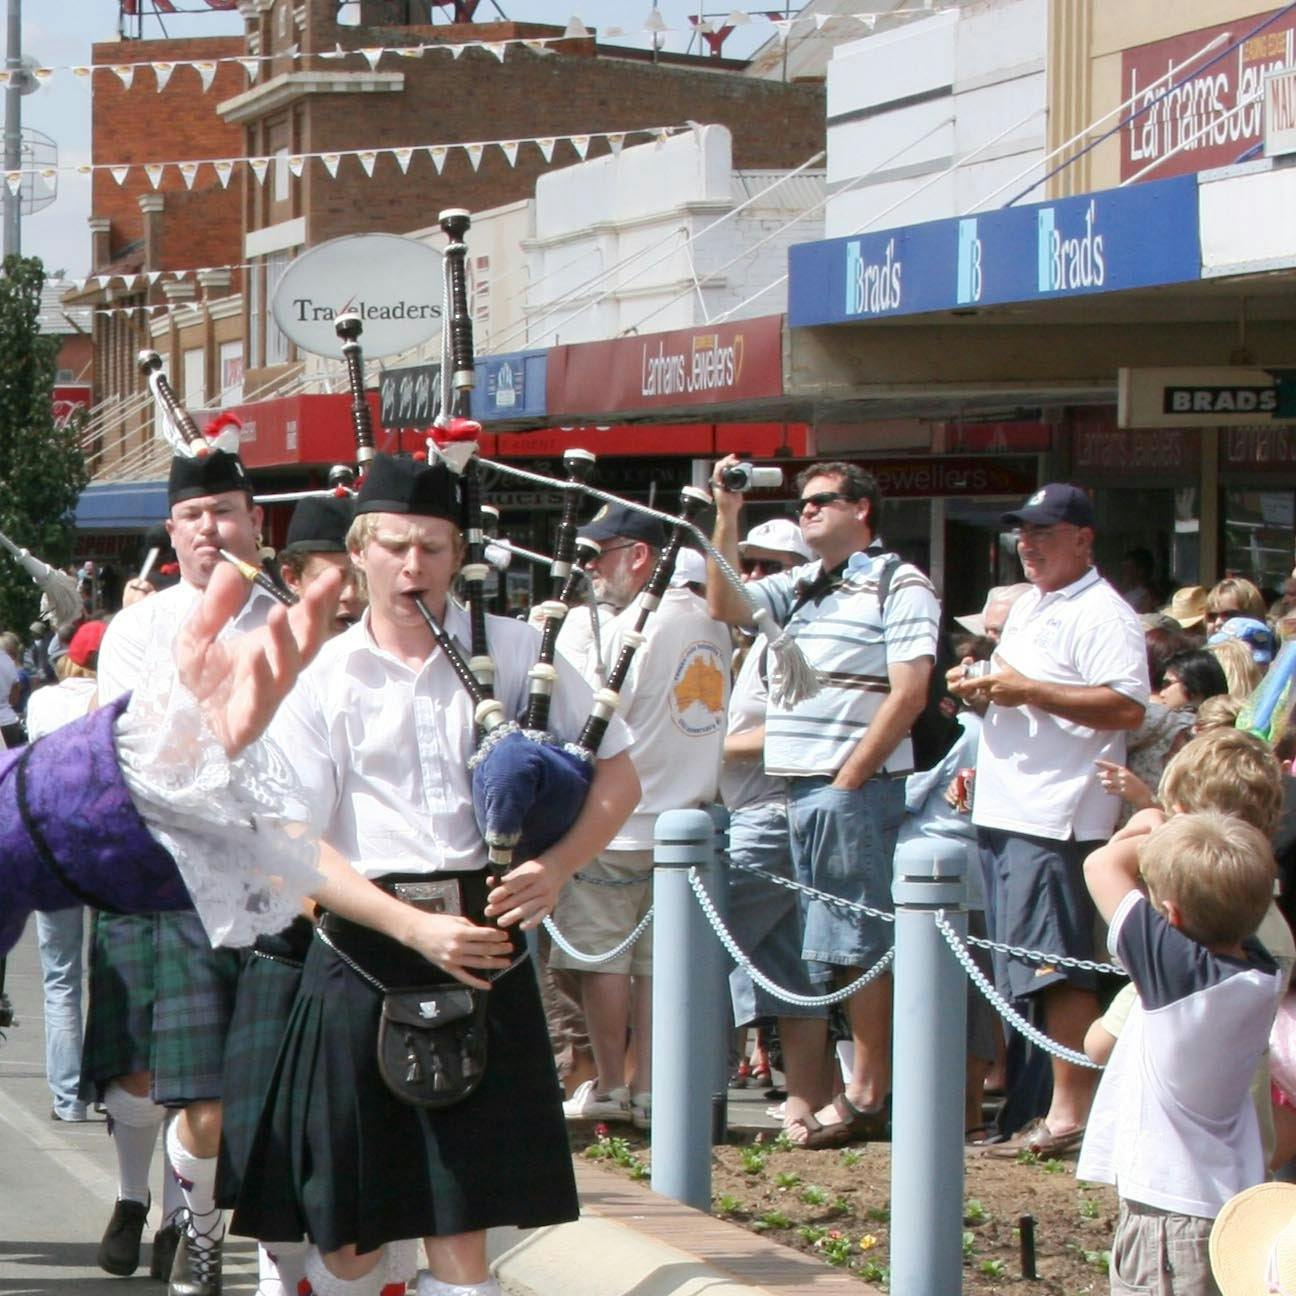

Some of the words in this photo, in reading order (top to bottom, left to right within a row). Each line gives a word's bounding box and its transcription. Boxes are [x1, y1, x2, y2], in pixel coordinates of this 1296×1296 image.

[1129, 59, 1228, 161] Lanhams
[855, 237, 901, 314] Brad's
[1050, 199, 1104, 291] Brad's
[641, 341, 685, 396] Lanhams
[1171, 390, 1278, 412] BRADS
[873, 464, 987, 491] ewellers
